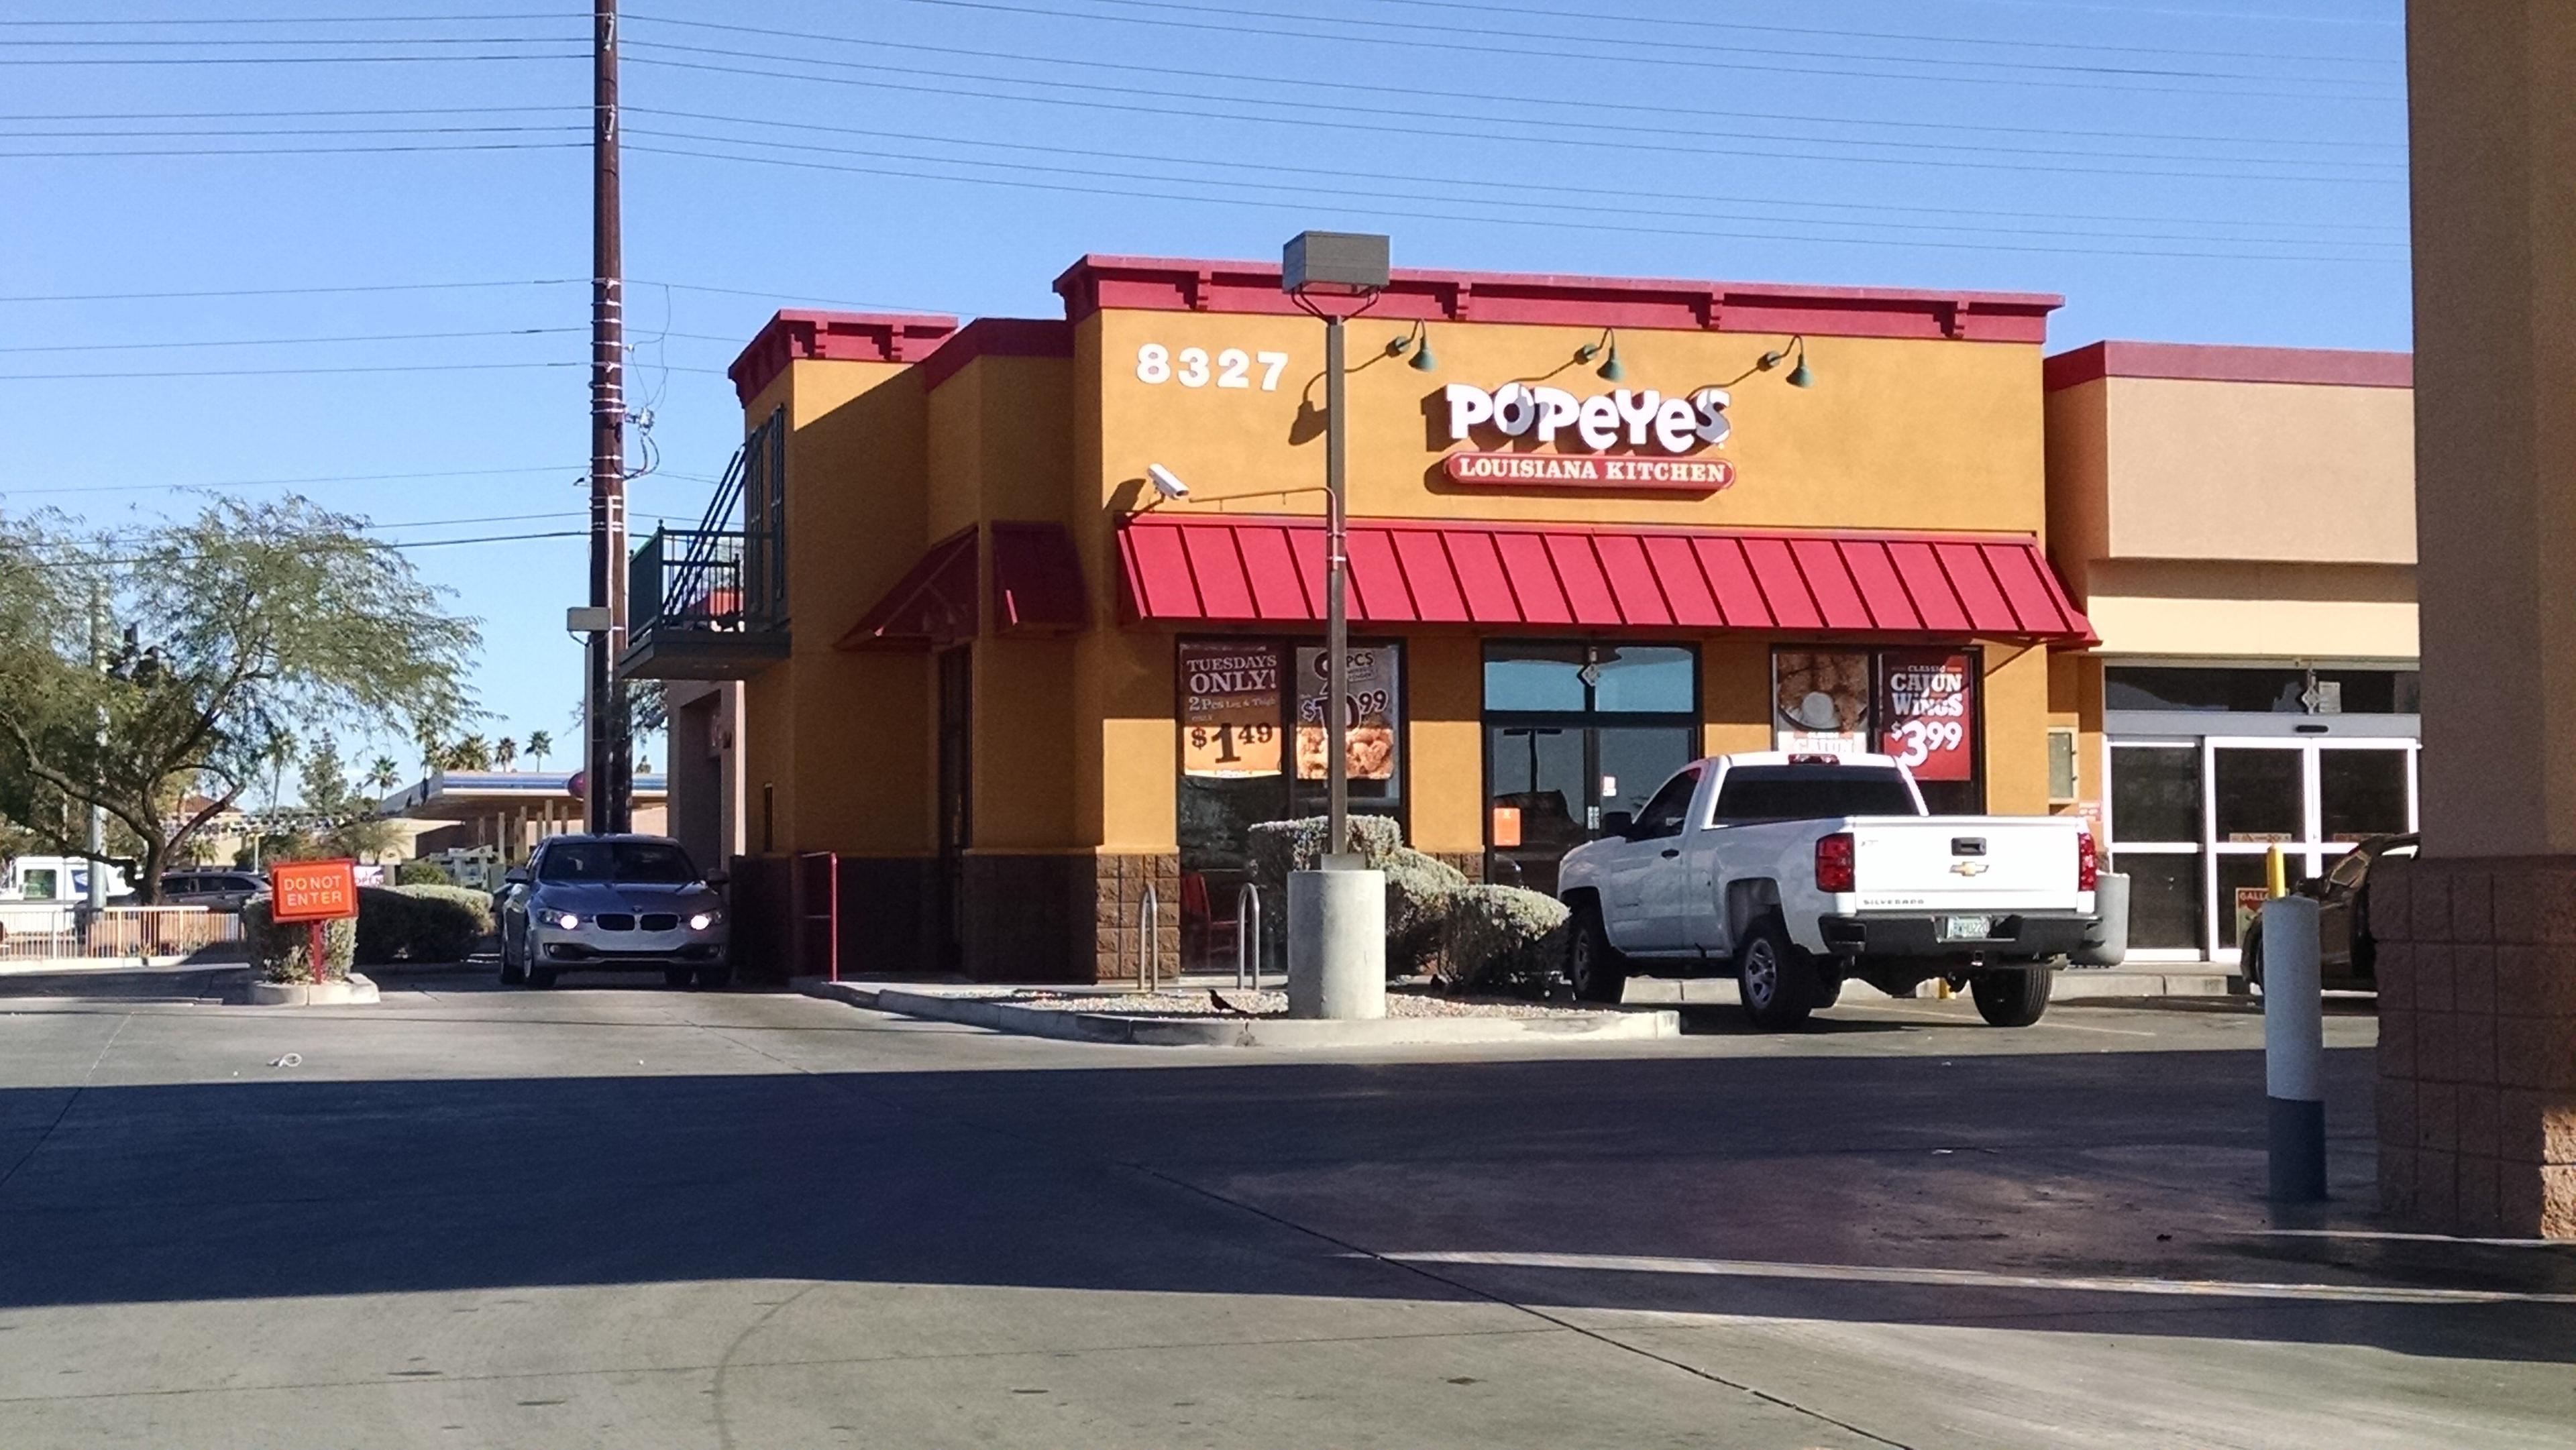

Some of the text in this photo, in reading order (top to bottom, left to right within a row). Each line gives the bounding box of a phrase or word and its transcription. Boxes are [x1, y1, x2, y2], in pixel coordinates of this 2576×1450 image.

[1137, 343, 1289, 392] 8327
[1459, 457, 1725, 483] LOUISIANA KITCHEN
[1187, 655, 1277, 672] TUESDAYS
[1189, 669, 1277, 694] ONLY!
[1890, 672, 1963, 698] CAJUN
[284, 875, 342, 891] DO NOT
[287, 891, 342, 907] ENTER
